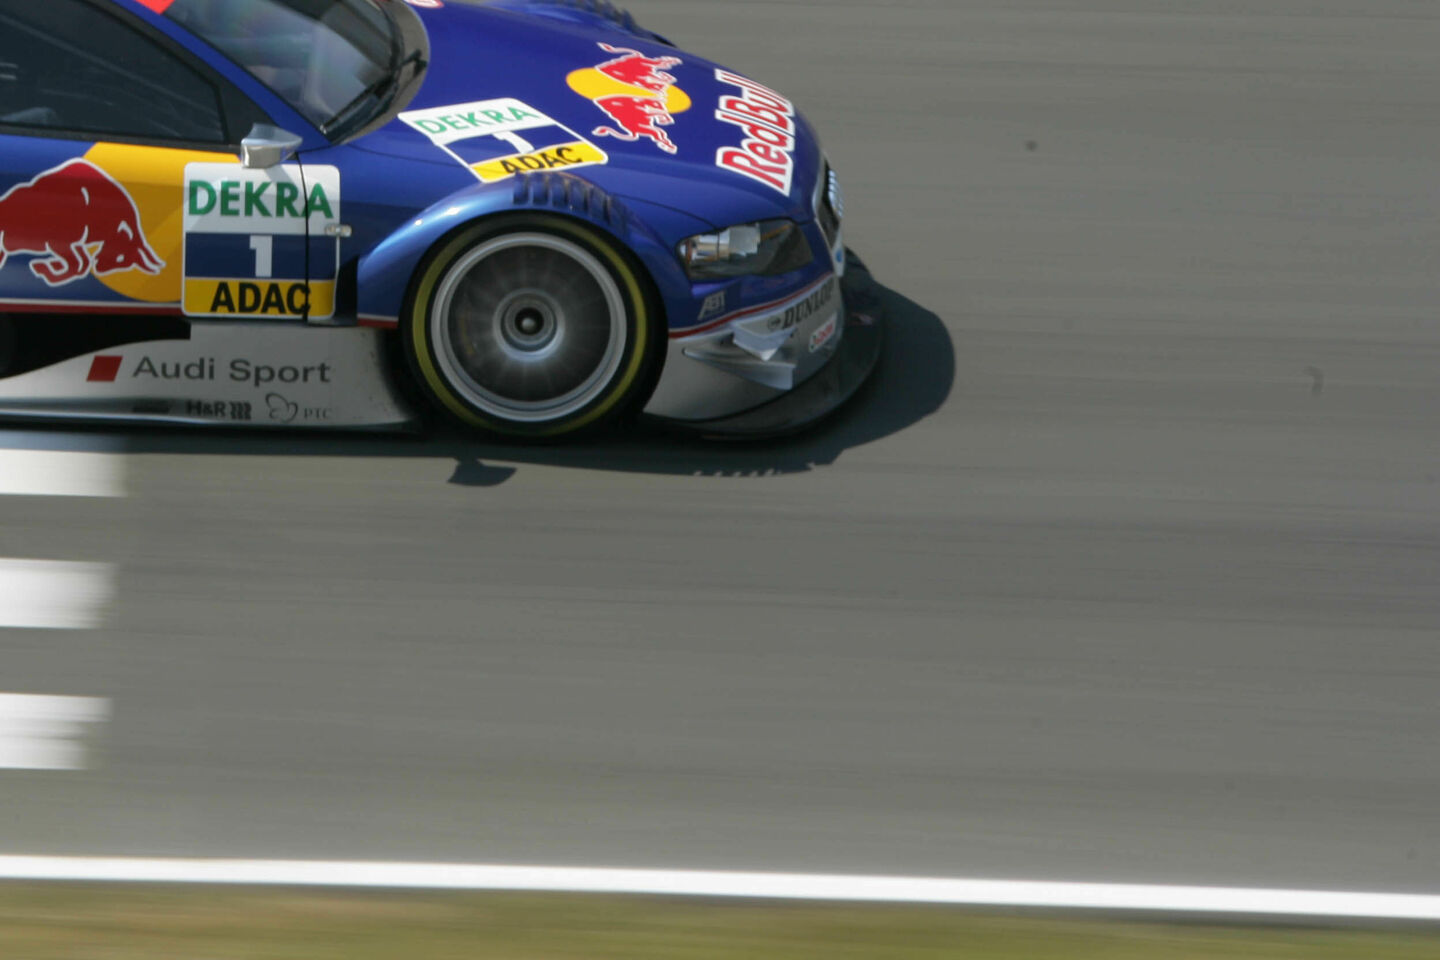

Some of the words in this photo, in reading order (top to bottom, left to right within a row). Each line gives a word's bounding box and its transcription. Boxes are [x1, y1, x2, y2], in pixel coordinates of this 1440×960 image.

[413, 106, 541, 135] DEKRA
[491, 131, 535, 155] 1
[499, 146, 583, 175] ADAC
[188, 179, 335, 220] DEKRA
[249, 235, 273, 278] 1
[210, 280, 312, 316] ADAC
[131, 355, 216, 381] Audi
[228, 358, 332, 388] Sport
[186, 399, 227, 418] H&R
